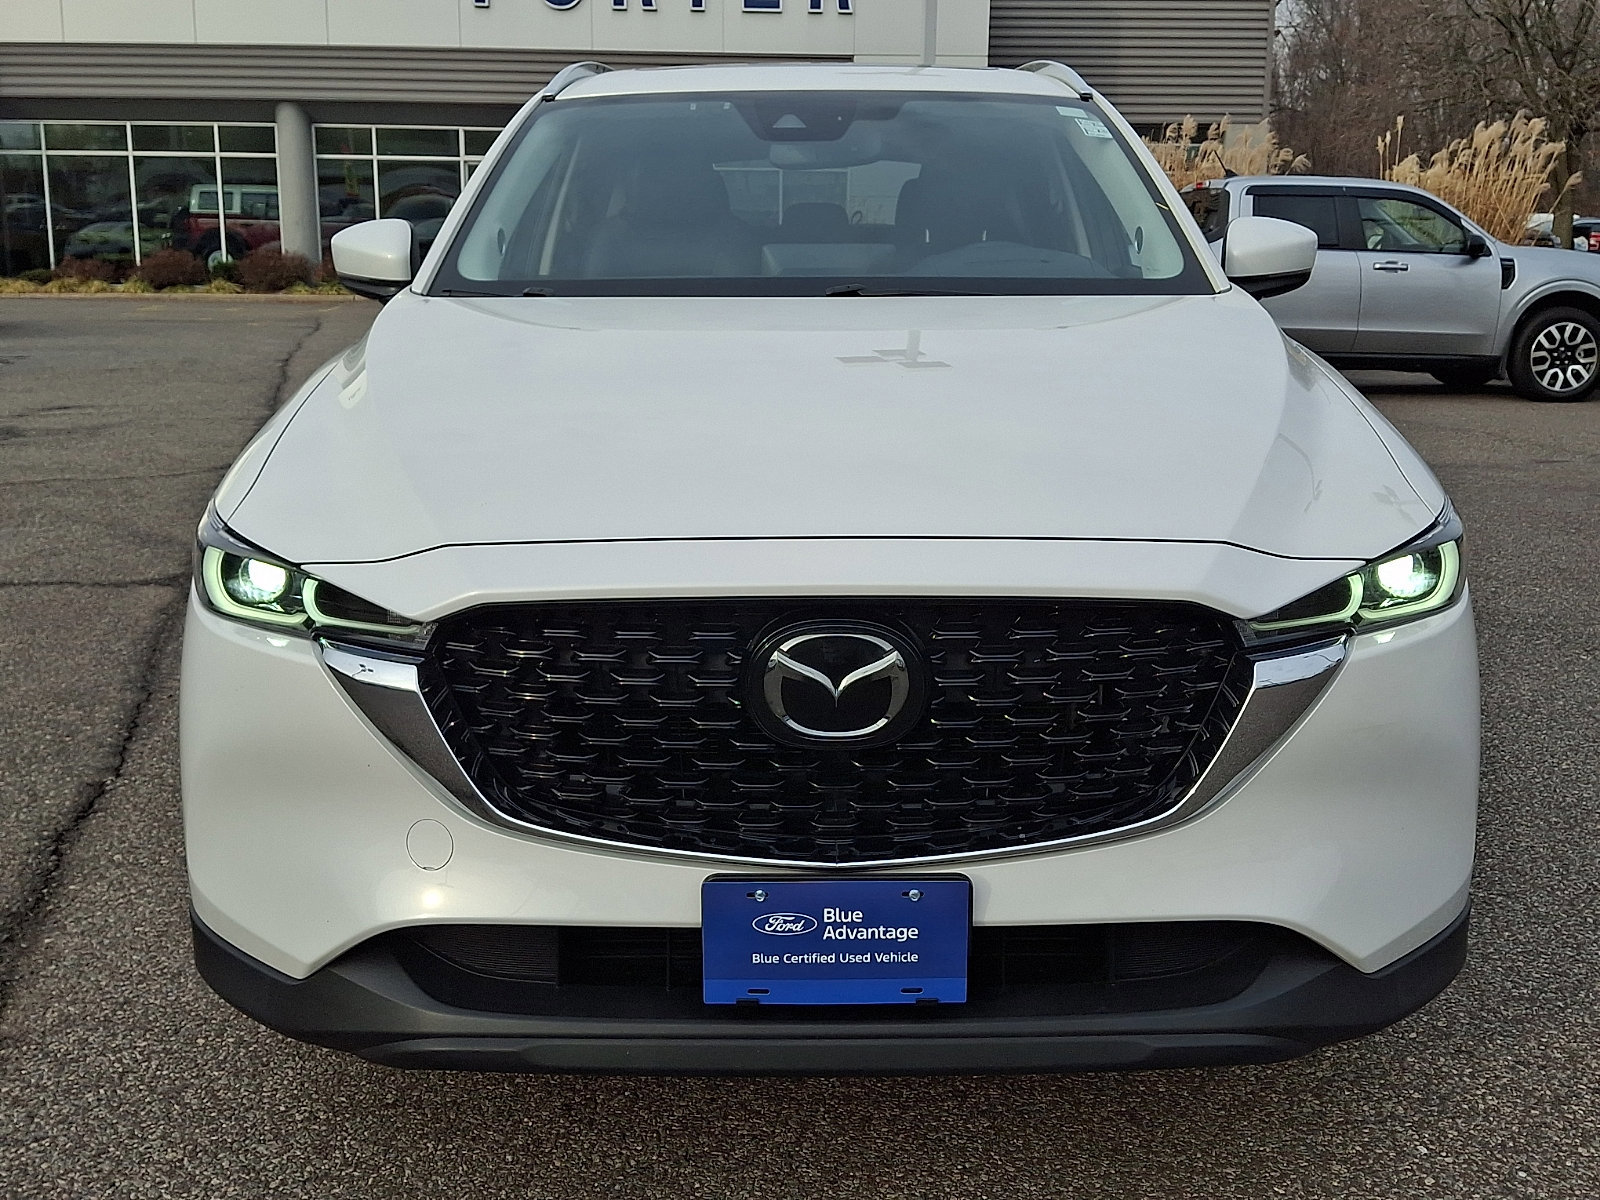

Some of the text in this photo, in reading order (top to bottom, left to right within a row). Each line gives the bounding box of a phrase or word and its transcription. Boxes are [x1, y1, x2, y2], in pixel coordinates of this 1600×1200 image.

[823, 908, 863, 922] Blue
[764, 915, 805, 932] Ford
[823, 925, 918, 942] Advantage
[752, 951, 919, 964] Blue Certified Used Vehicle
